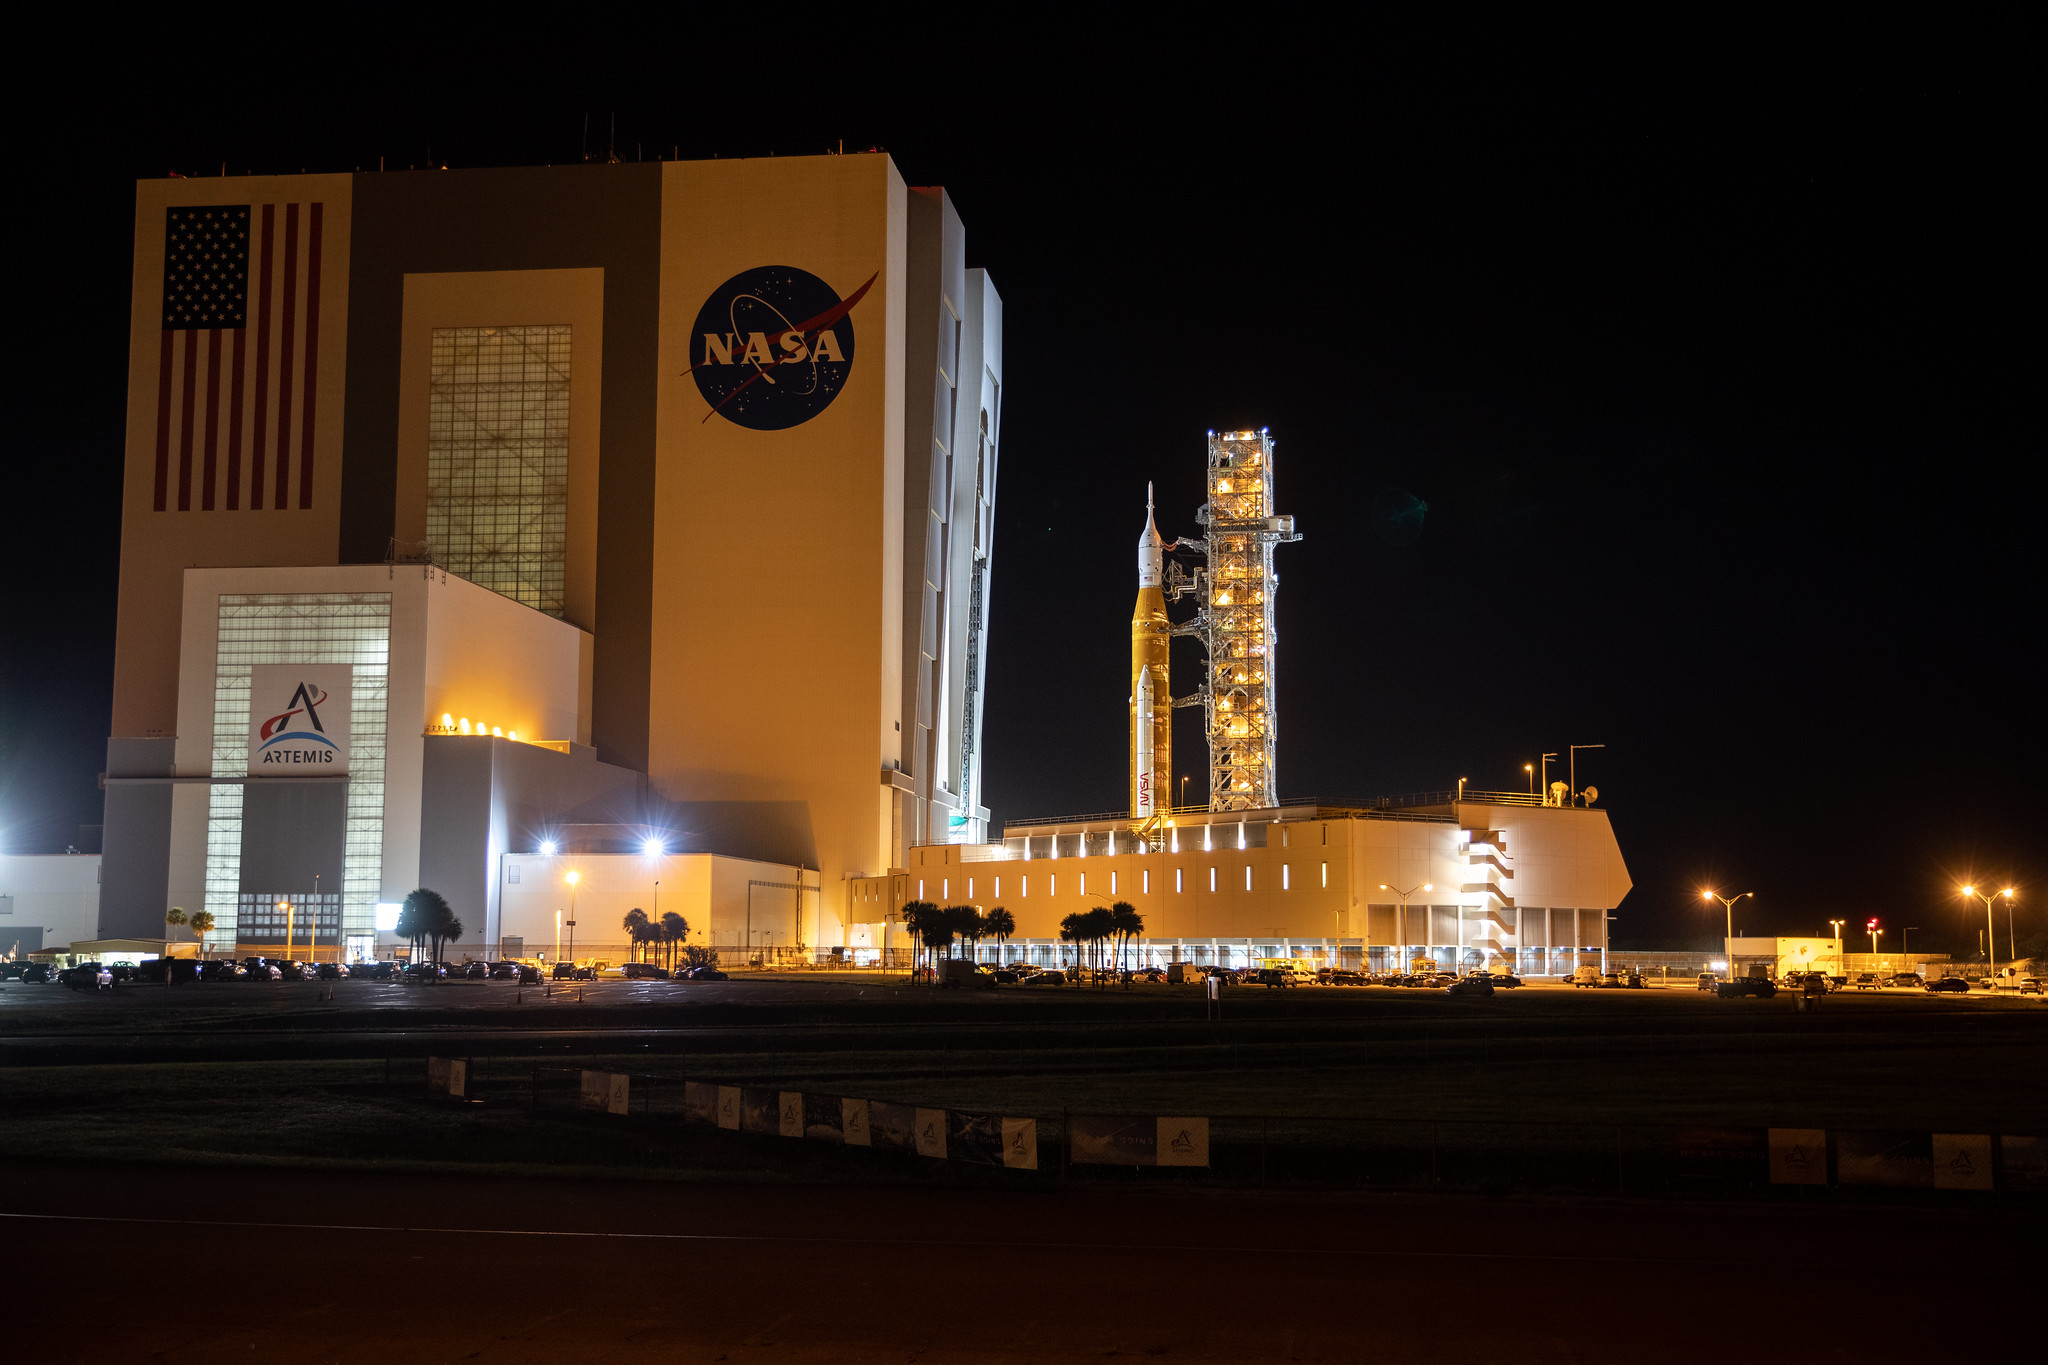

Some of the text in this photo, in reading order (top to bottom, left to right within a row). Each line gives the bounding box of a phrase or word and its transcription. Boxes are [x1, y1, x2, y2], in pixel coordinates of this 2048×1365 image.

[702, 329, 846, 366] NASA
[263, 750, 333, 764] ARTEMIS
[1139, 772, 1149, 806] NASA
